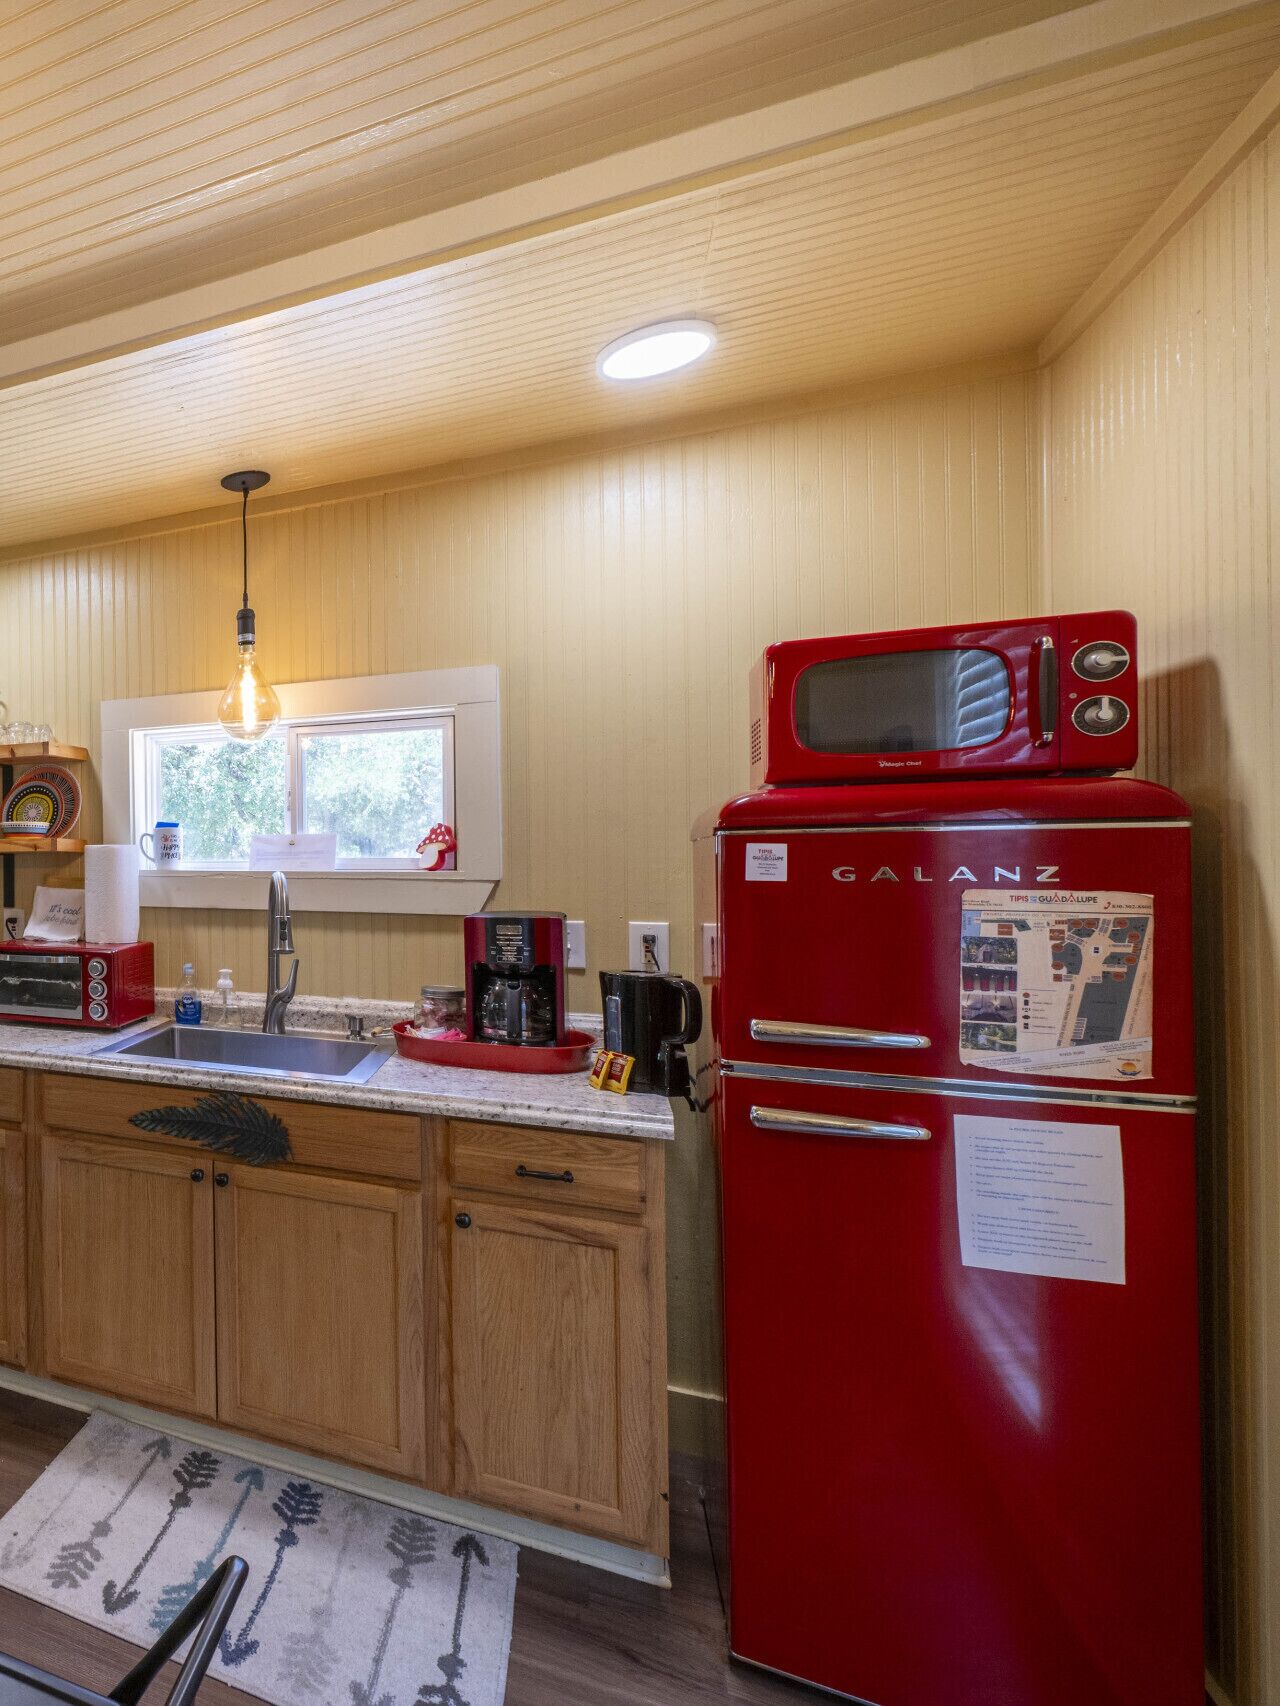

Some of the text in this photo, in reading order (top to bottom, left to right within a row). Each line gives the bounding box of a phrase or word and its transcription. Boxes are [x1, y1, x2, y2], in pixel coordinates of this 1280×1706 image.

[832, 866, 1060, 882] GALANZ
[1009, 894, 1029, 903] TIPIS
[1038, 892, 1098, 904] GUADALUPE
